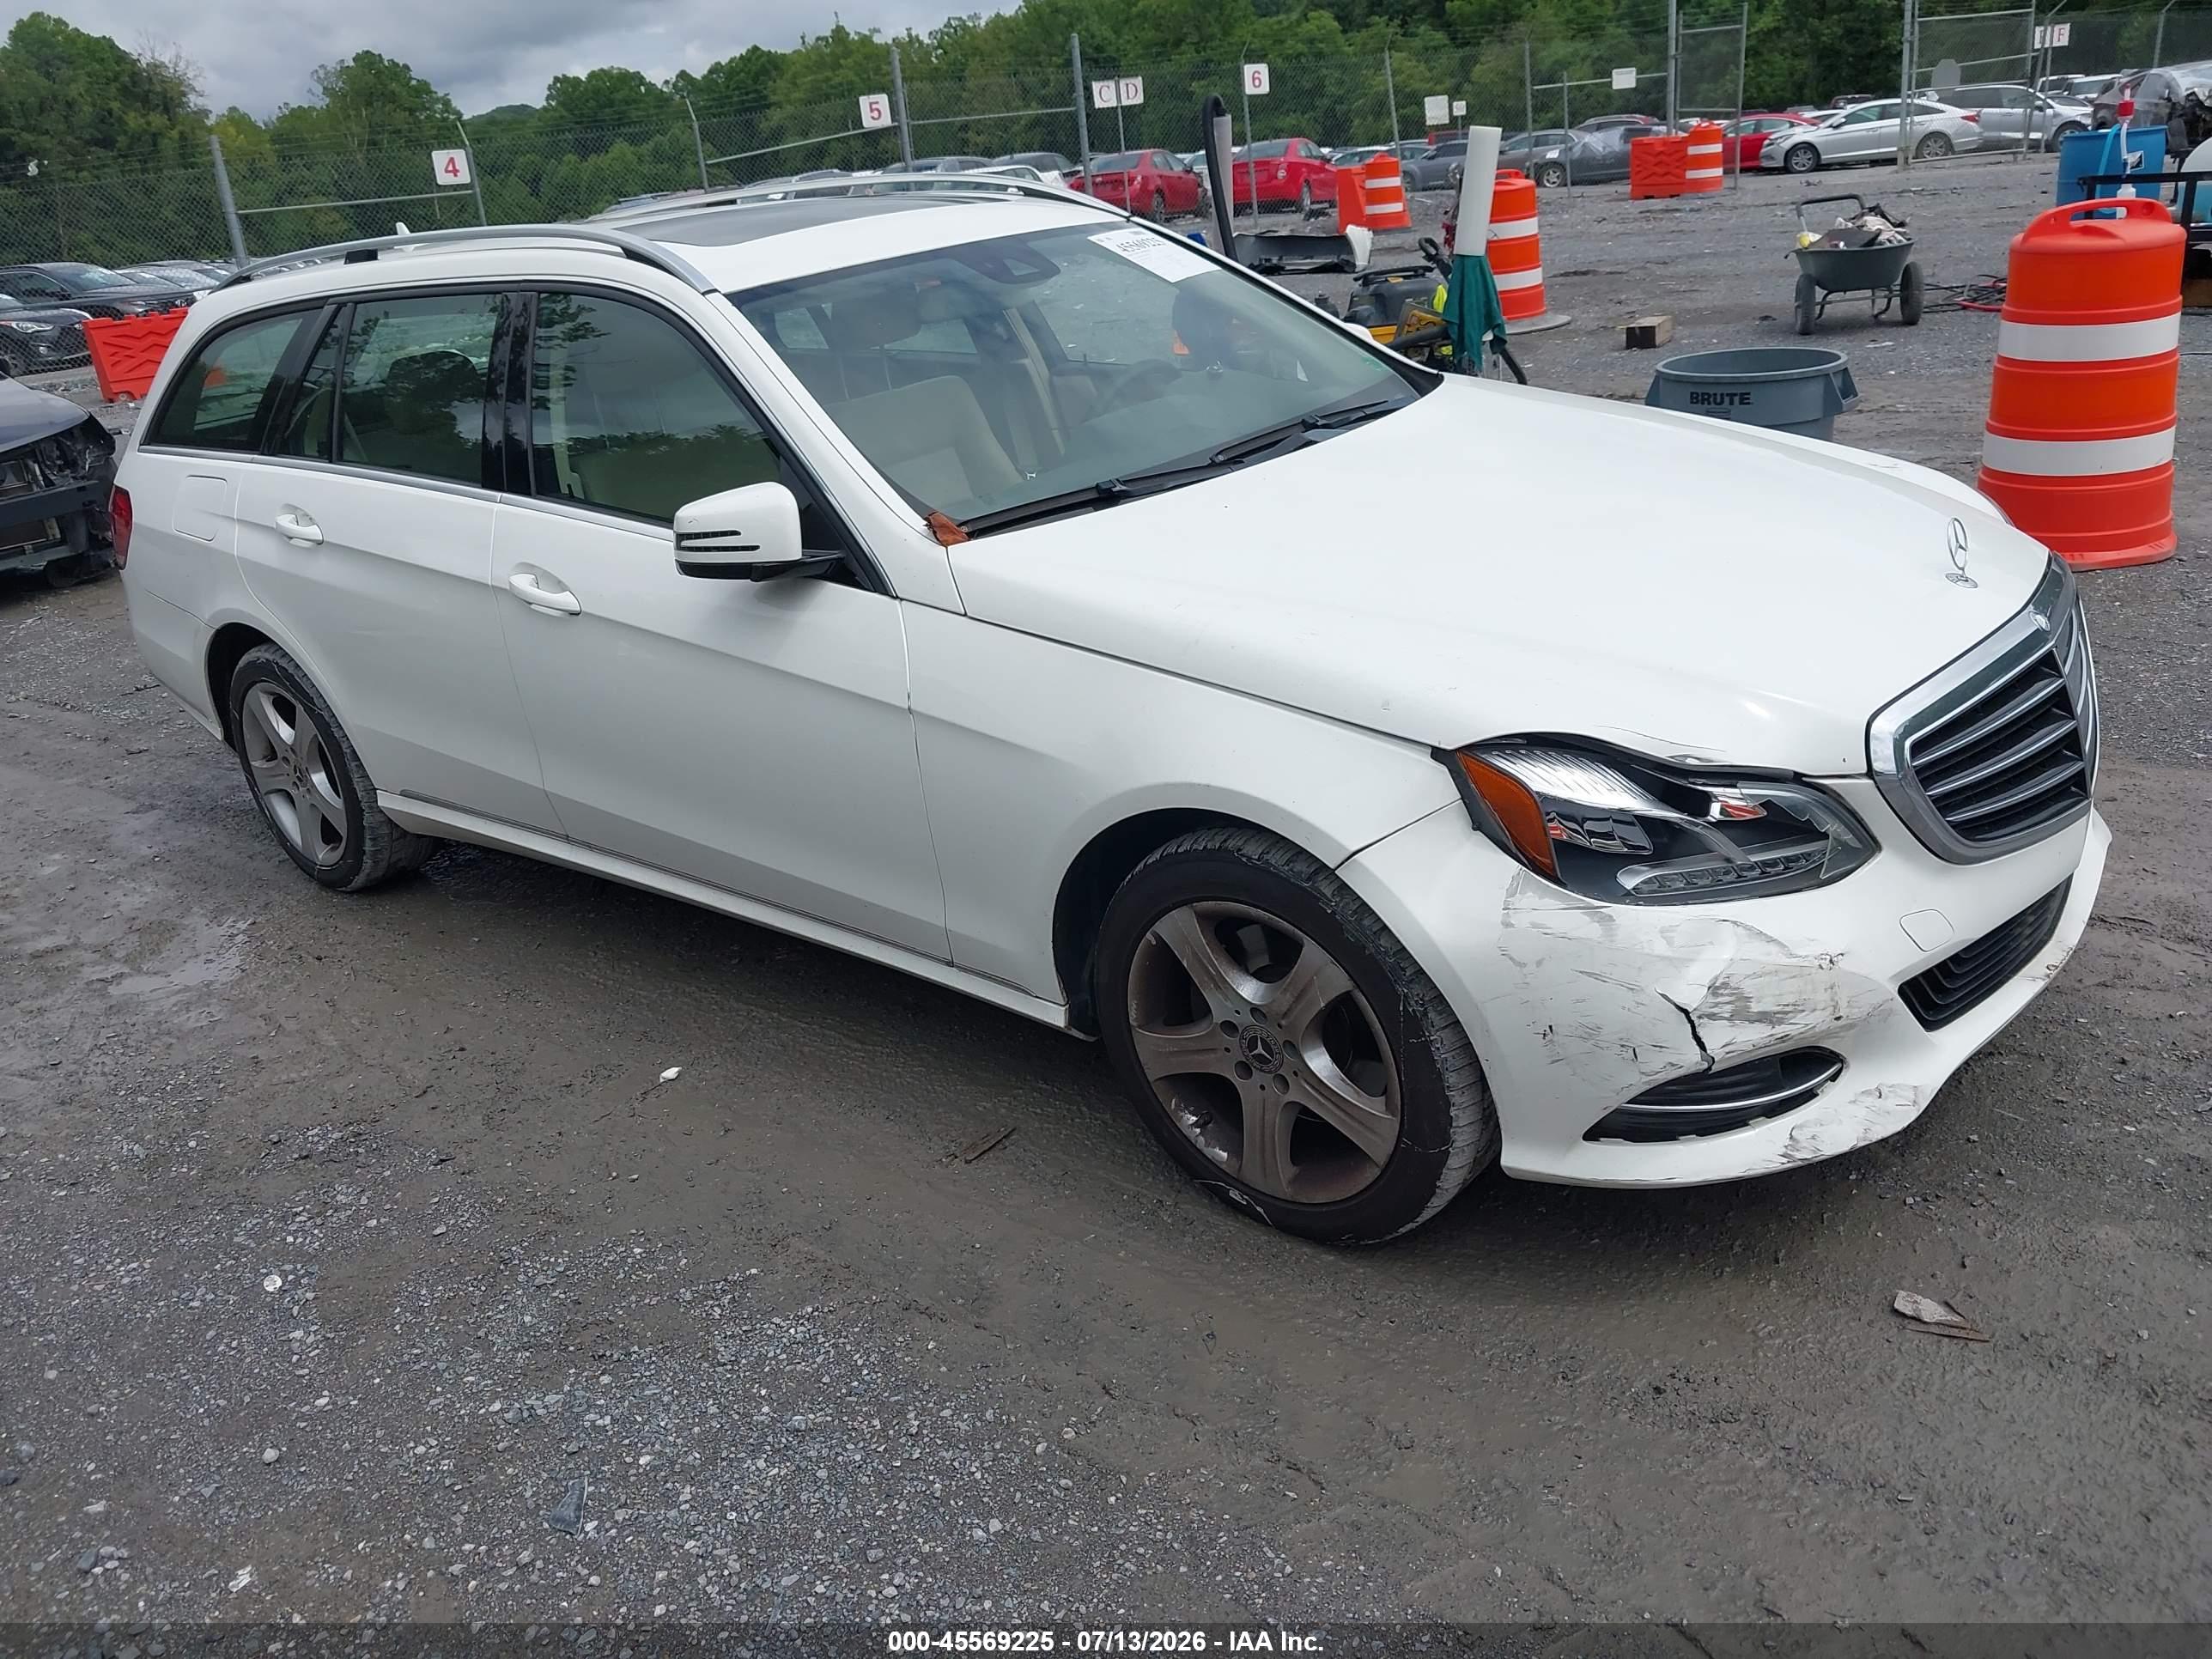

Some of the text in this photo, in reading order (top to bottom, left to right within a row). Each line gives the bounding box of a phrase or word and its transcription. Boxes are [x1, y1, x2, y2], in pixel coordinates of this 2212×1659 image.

[2057, 27, 2066, 42] F
[1251, 70, 1262, 88] 6
[1098, 85, 1111, 103] C
[1126, 82, 1139, 100] D
[868, 101, 883, 121] 5
[443, 156, 461, 179] 4
[1690, 392, 1751, 405] BRUTE
